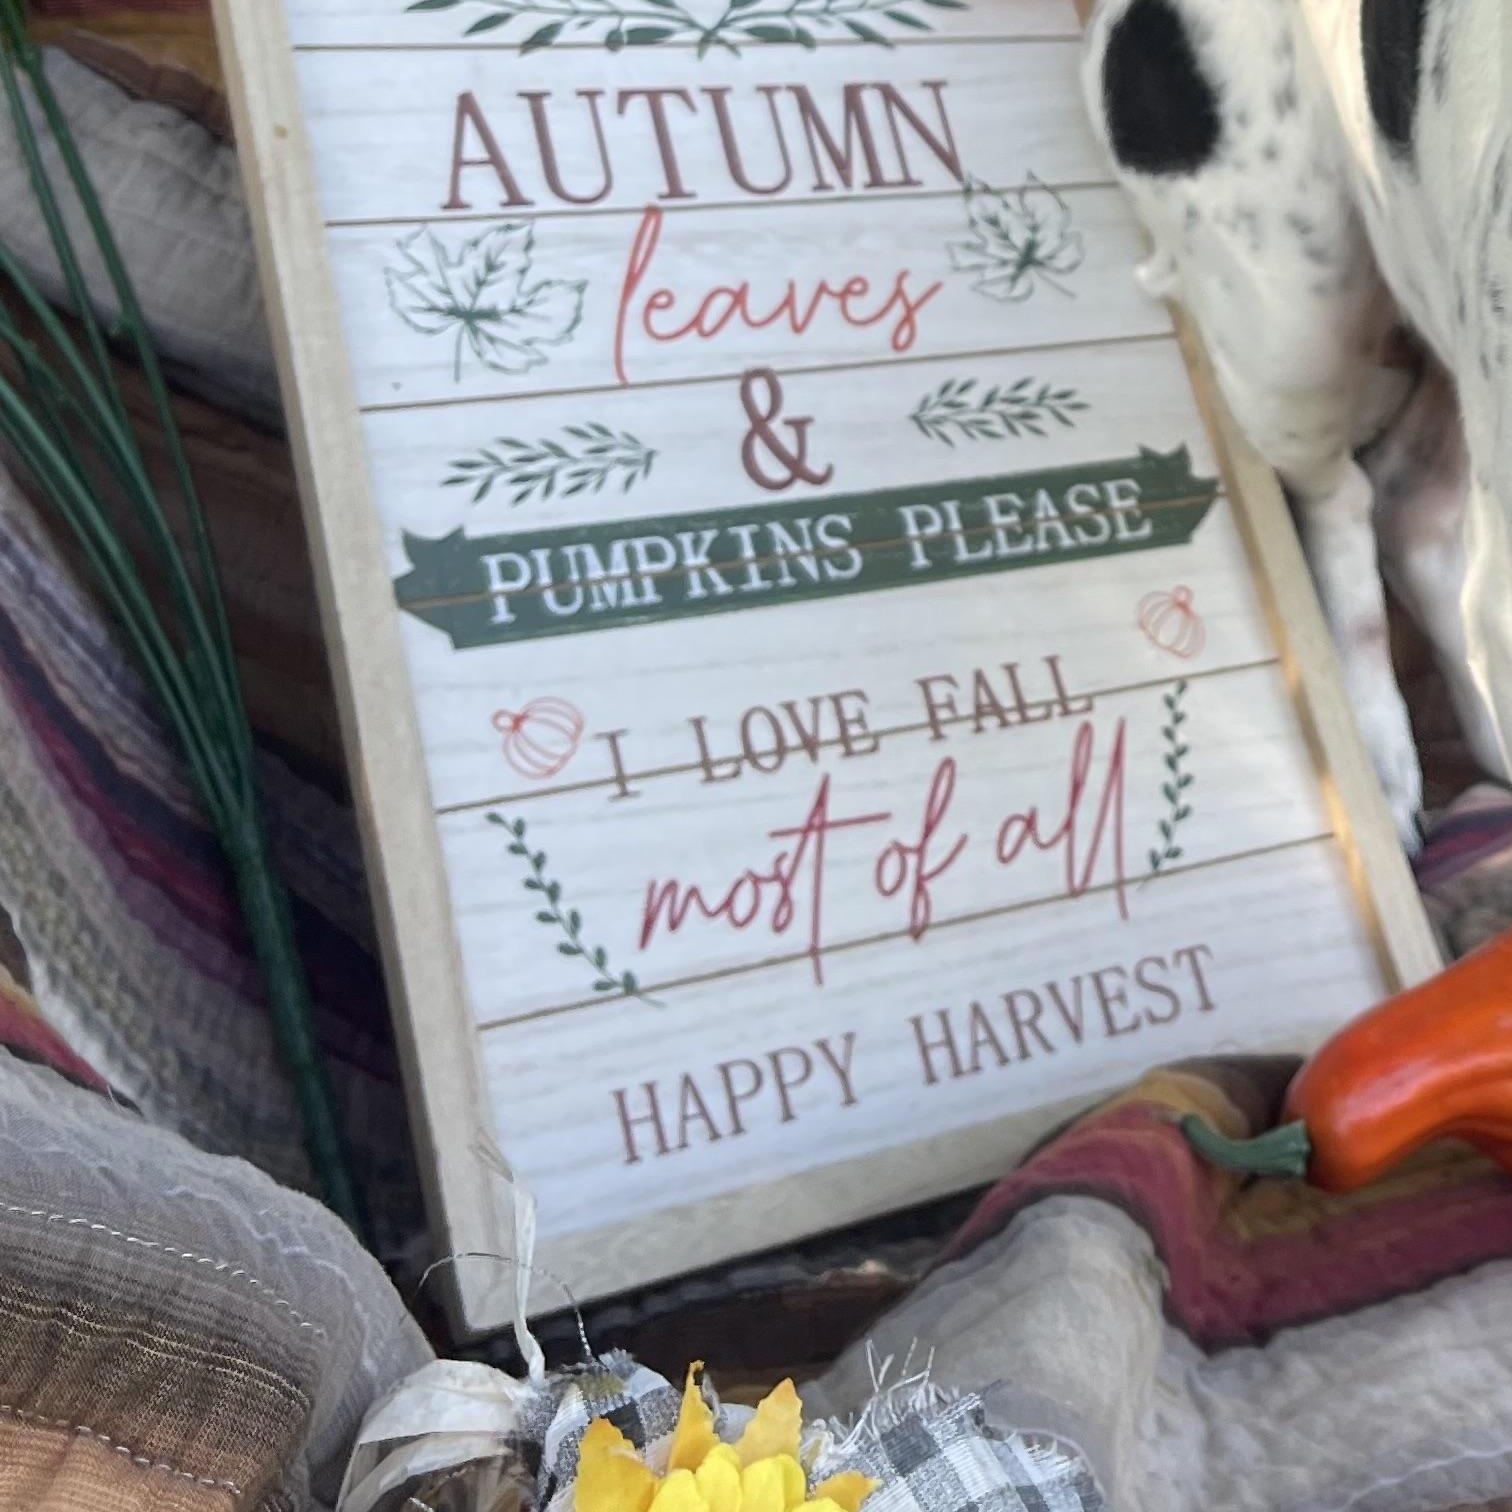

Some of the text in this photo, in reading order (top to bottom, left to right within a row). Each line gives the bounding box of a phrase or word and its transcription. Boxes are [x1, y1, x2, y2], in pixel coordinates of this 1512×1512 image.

[442, 80, 965, 209] AUTUMN
[613, 203, 943, 385] leaves
[739, 366, 833, 490] &
[479, 478, 1154, 625] PUMPKINS PLEASE
[595, 655, 1095, 801] I LOVE FALL
[639, 717, 1129, 986] most of all
[611, 943, 1217, 1165] HAPPY HARVEST
